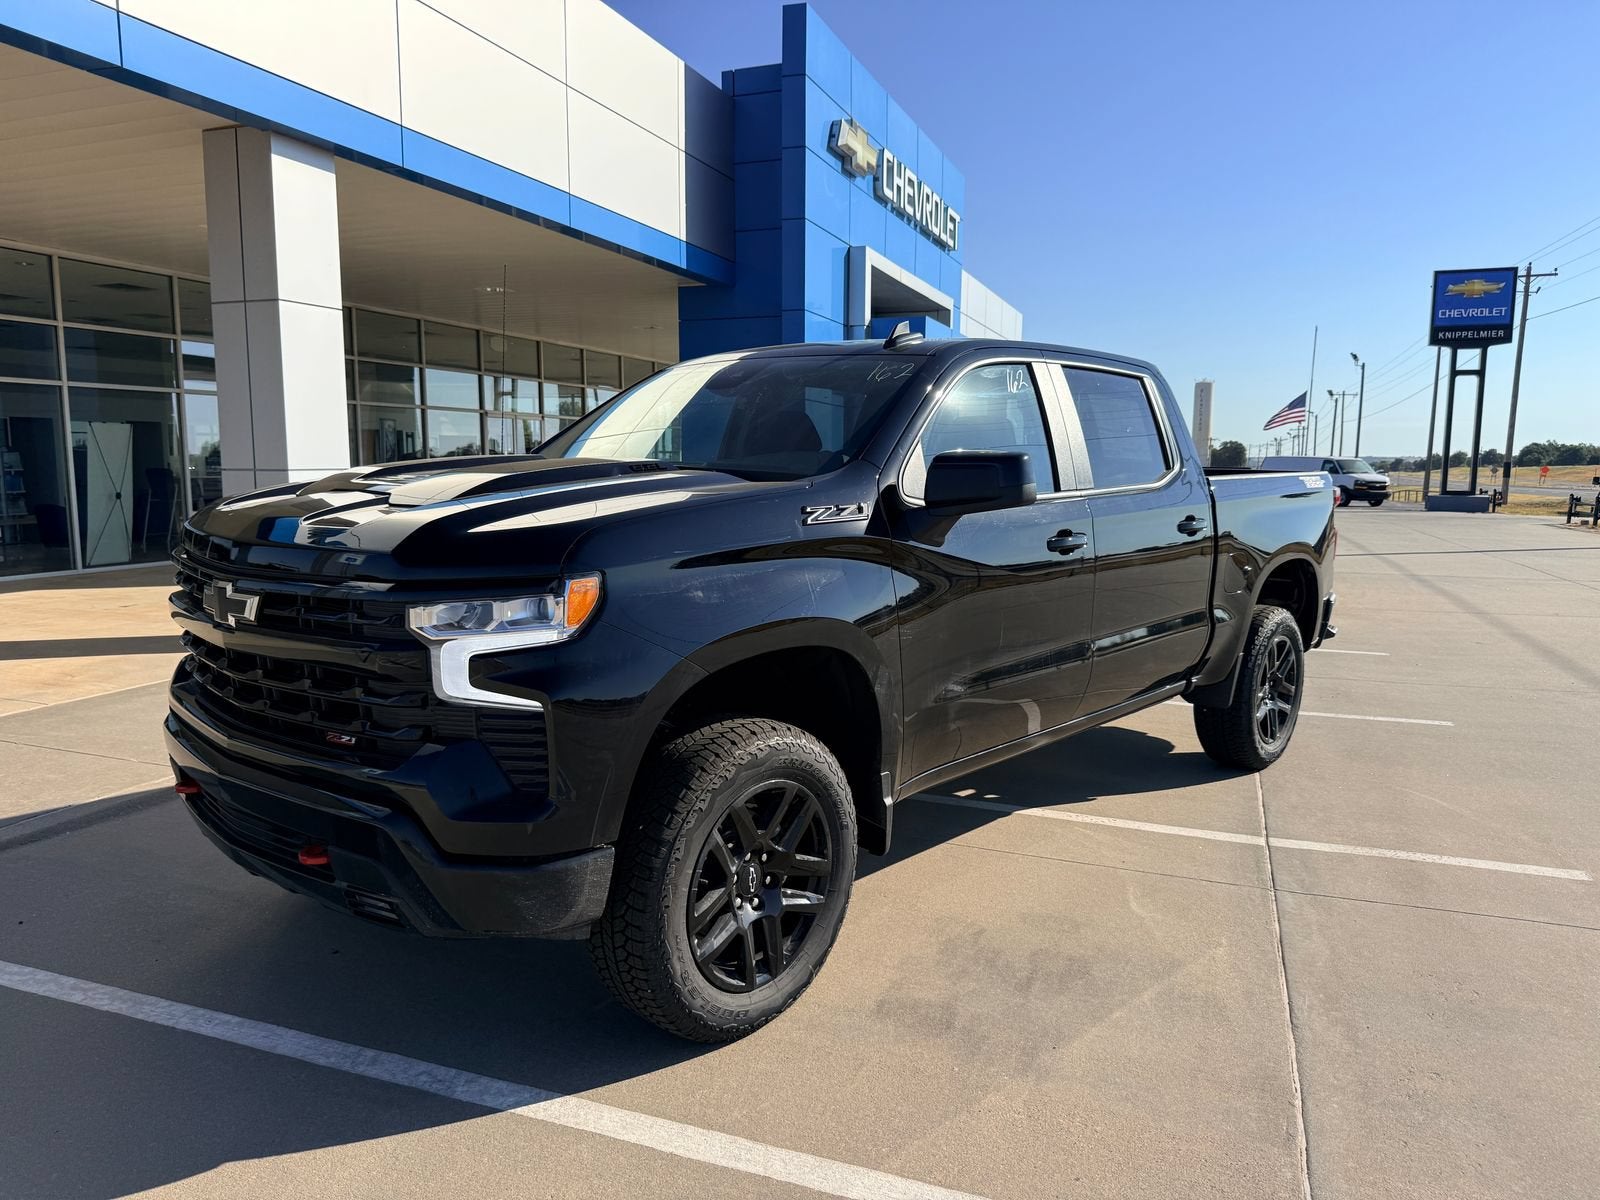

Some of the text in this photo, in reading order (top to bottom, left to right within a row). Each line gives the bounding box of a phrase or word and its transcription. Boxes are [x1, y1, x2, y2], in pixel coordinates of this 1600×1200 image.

[880, 148, 960, 251] CHEVROLET
[1438, 306, 1508, 319] CHEVROLET
[1438, 330, 1505, 340] KNIPPELMIER
[866, 361, 915, 383] 162
[1006, 368, 1029, 394] 162
[801, 502, 871, 526] Z71
[325, 731, 357, 747] Z71
